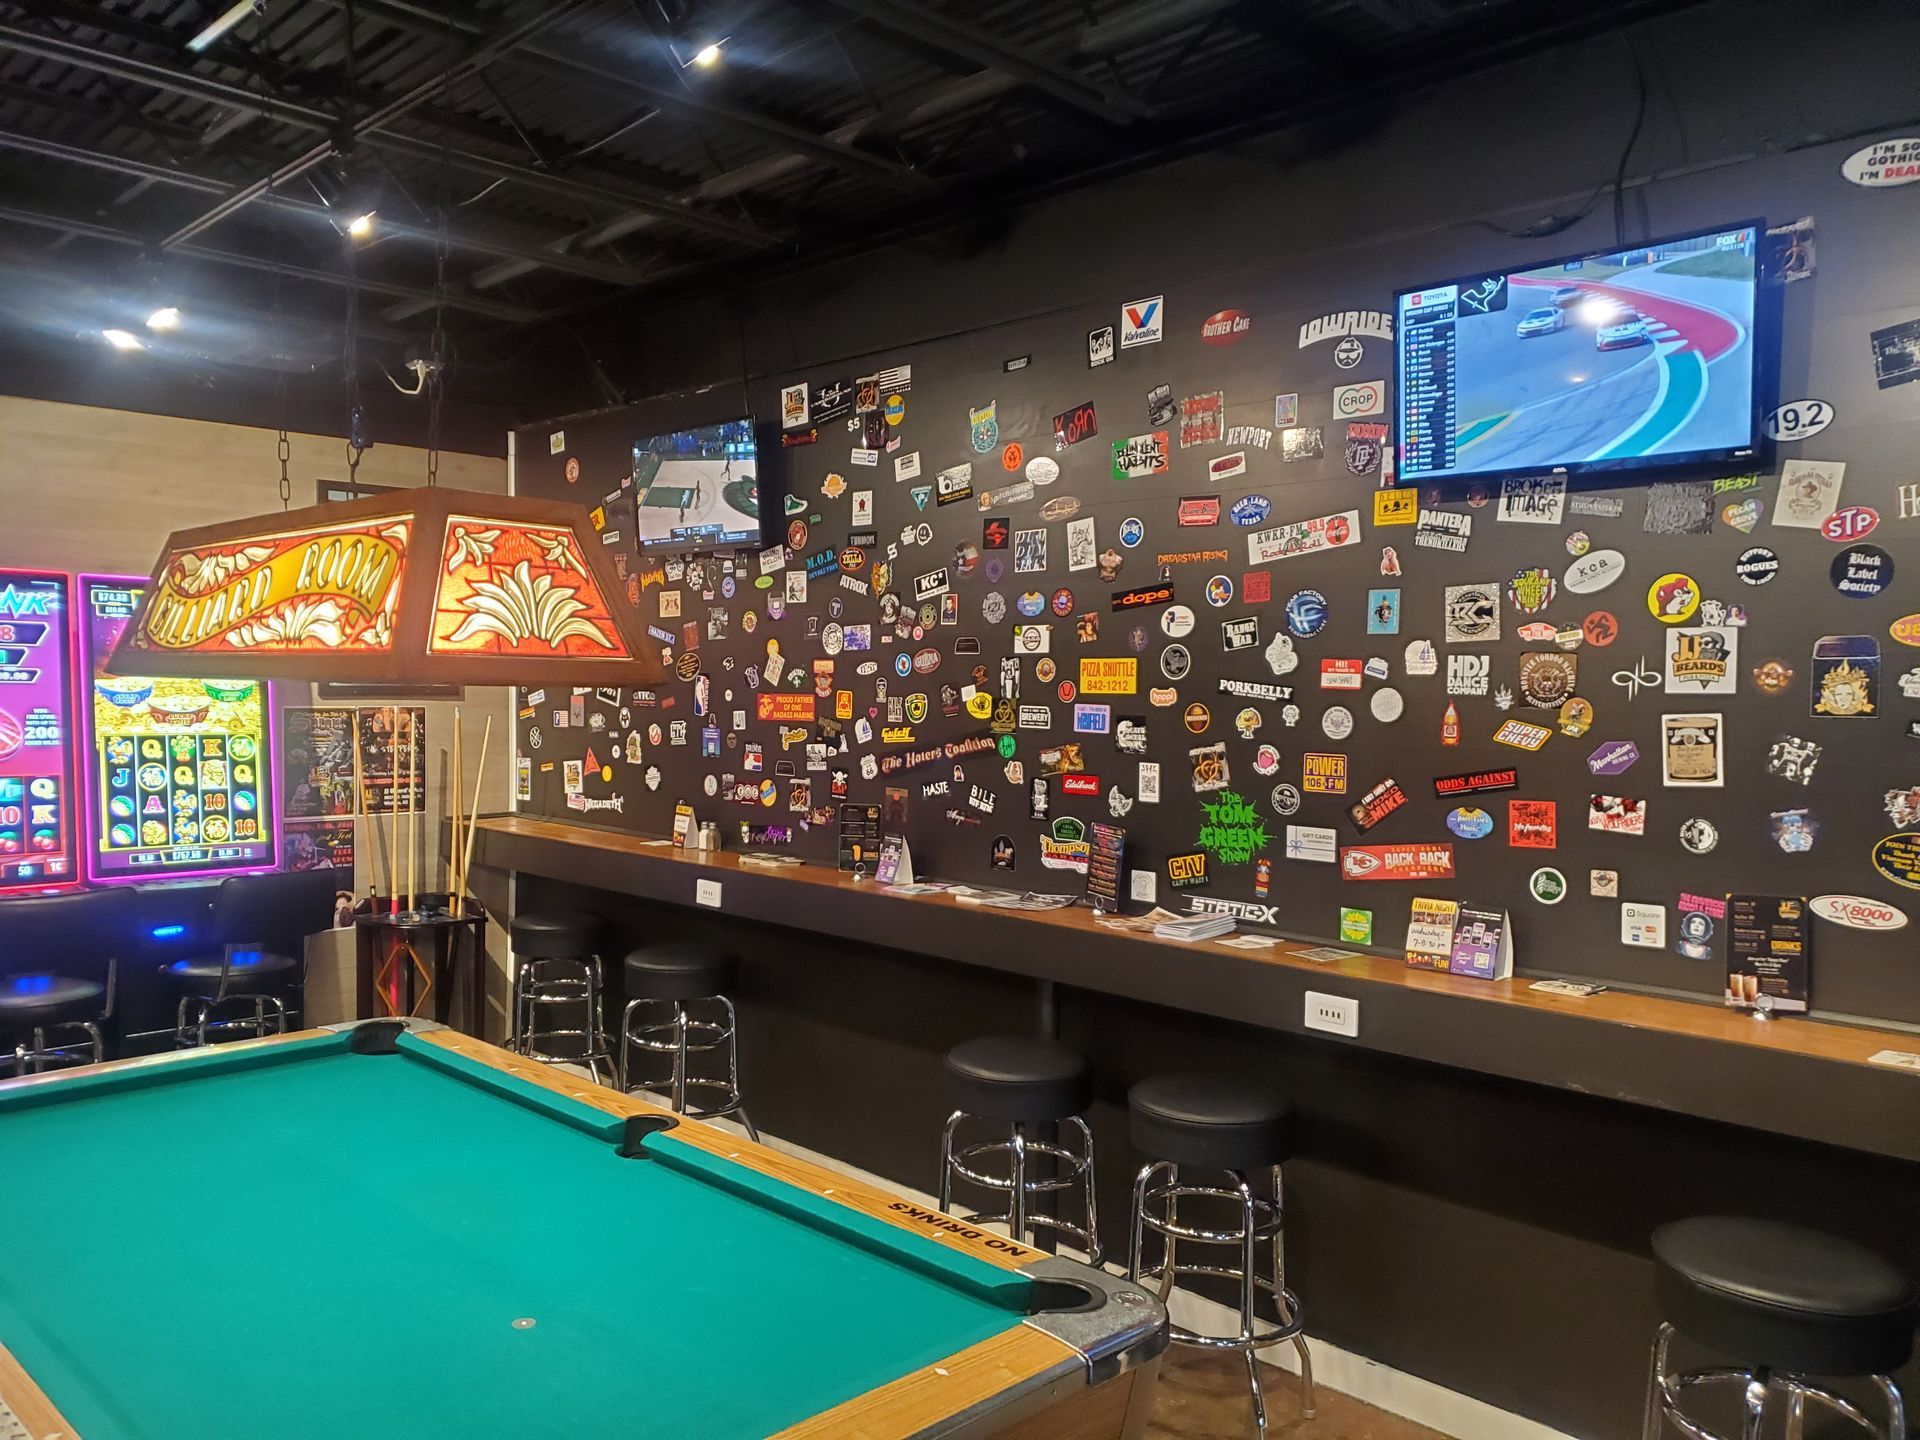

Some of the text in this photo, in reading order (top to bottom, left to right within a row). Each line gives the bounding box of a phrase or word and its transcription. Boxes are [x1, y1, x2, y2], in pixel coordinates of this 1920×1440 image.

[1872, 143, 1896, 156] I'M
[1859, 169, 1879, 182] I'M
[1124, 327, 1159, 342] Valvoline
[1343, 394, 1374, 407] CROP
[847, 417, 860, 432] $5
[1768, 402, 1825, 434] 19.2
[1225, 425, 1273, 451] NEWPORT
[1117, 454, 1166, 471] HABITS
[1728, 502, 1756, 517] PECAN
[1241, 516, 1261, 526] TEXAS
[1306, 519, 1325, 534] 99.9
[1417, 509, 1472, 537] PANTERA
[1730, 512, 1758, 526] GROVE
[1828, 508, 1872, 537] STP
[806, 549, 837, 570] M.O.D.
[1157, 549, 1228, 566] DREADSTAR RISING
[1740, 547, 1774, 562] SUPPORT
[1849, 552, 1882, 566] Black
[1736, 560, 1779, 574] ROGUES
[1847, 566, 1878, 580] Label
[150, 540, 391, 643] BILLIARD ROOM
[840, 574, 869, 597] ATROX
[1838, 579, 1882, 594] Society
[1123, 590, 1170, 606] dope
[1298, 589, 1328, 606] FACTORY
[1226, 621, 1256, 637] RANGE
[1231, 634, 1252, 648] WAR
[1082, 660, 1135, 678] PIZZA SHUTTLE
[1448, 655, 1490, 677] HDJ
[1087, 680, 1128, 691] 842-1212
[1219, 679, 1293, 699] PORKBELLY
[1447, 685, 1488, 696] COMPANY
[1448, 677, 1489, 688] DANCE
[773, 711, 793, 719] BADASS
[1021, 712, 1049, 722] BREWERY
[24, 726, 59, 740] 200
[1497, 731, 1542, 748] CHEVY
[1504, 722, 1546, 740] SUPER
[142, 738, 163, 759] Q
[202, 738, 223, 757] K
[1590, 743, 1633, 772] Manhattan
[173, 765, 195, 785] Q
[233, 764, 254, 784] Q
[866, 766, 874, 776] 66
[1305, 755, 1345, 778] POWER
[111, 767, 130, 788] J
[1064, 779, 1096, 790] Edelbrock
[1305, 776, 1344, 791] 106 FM
[1435, 770, 1516, 791] ODDS AGAINST
[30, 778, 58, 799] Q
[922, 781, 950, 797] HASTE
[970, 784, 996, 806] BILE
[142, 795, 165, 814] A
[203, 793, 226, 811] 10
[583, 795, 624, 814] MEGADETH
[1218, 791, 1242, 804] The
[1370, 789, 1407, 820] MIKE
[31, 805, 57, 825] K
[1207, 803, 1256, 823] TOM
[234, 818, 256, 835] 10
[1197, 824, 1268, 849] GREEN
[1314, 833, 1333, 841] CARDS
[1218, 848, 1251, 864] Show
[1384, 850, 1452, 870] BACK BACK
[1169, 854, 1205, 879] CIV
[1191, 897, 1280, 925] STATIC-X
[1414, 900, 1454, 913] TRIVIA NIGHT
[1636, 910, 1660, 919] Square
[887, 1201, 1029, 1258] NO DRINKS
